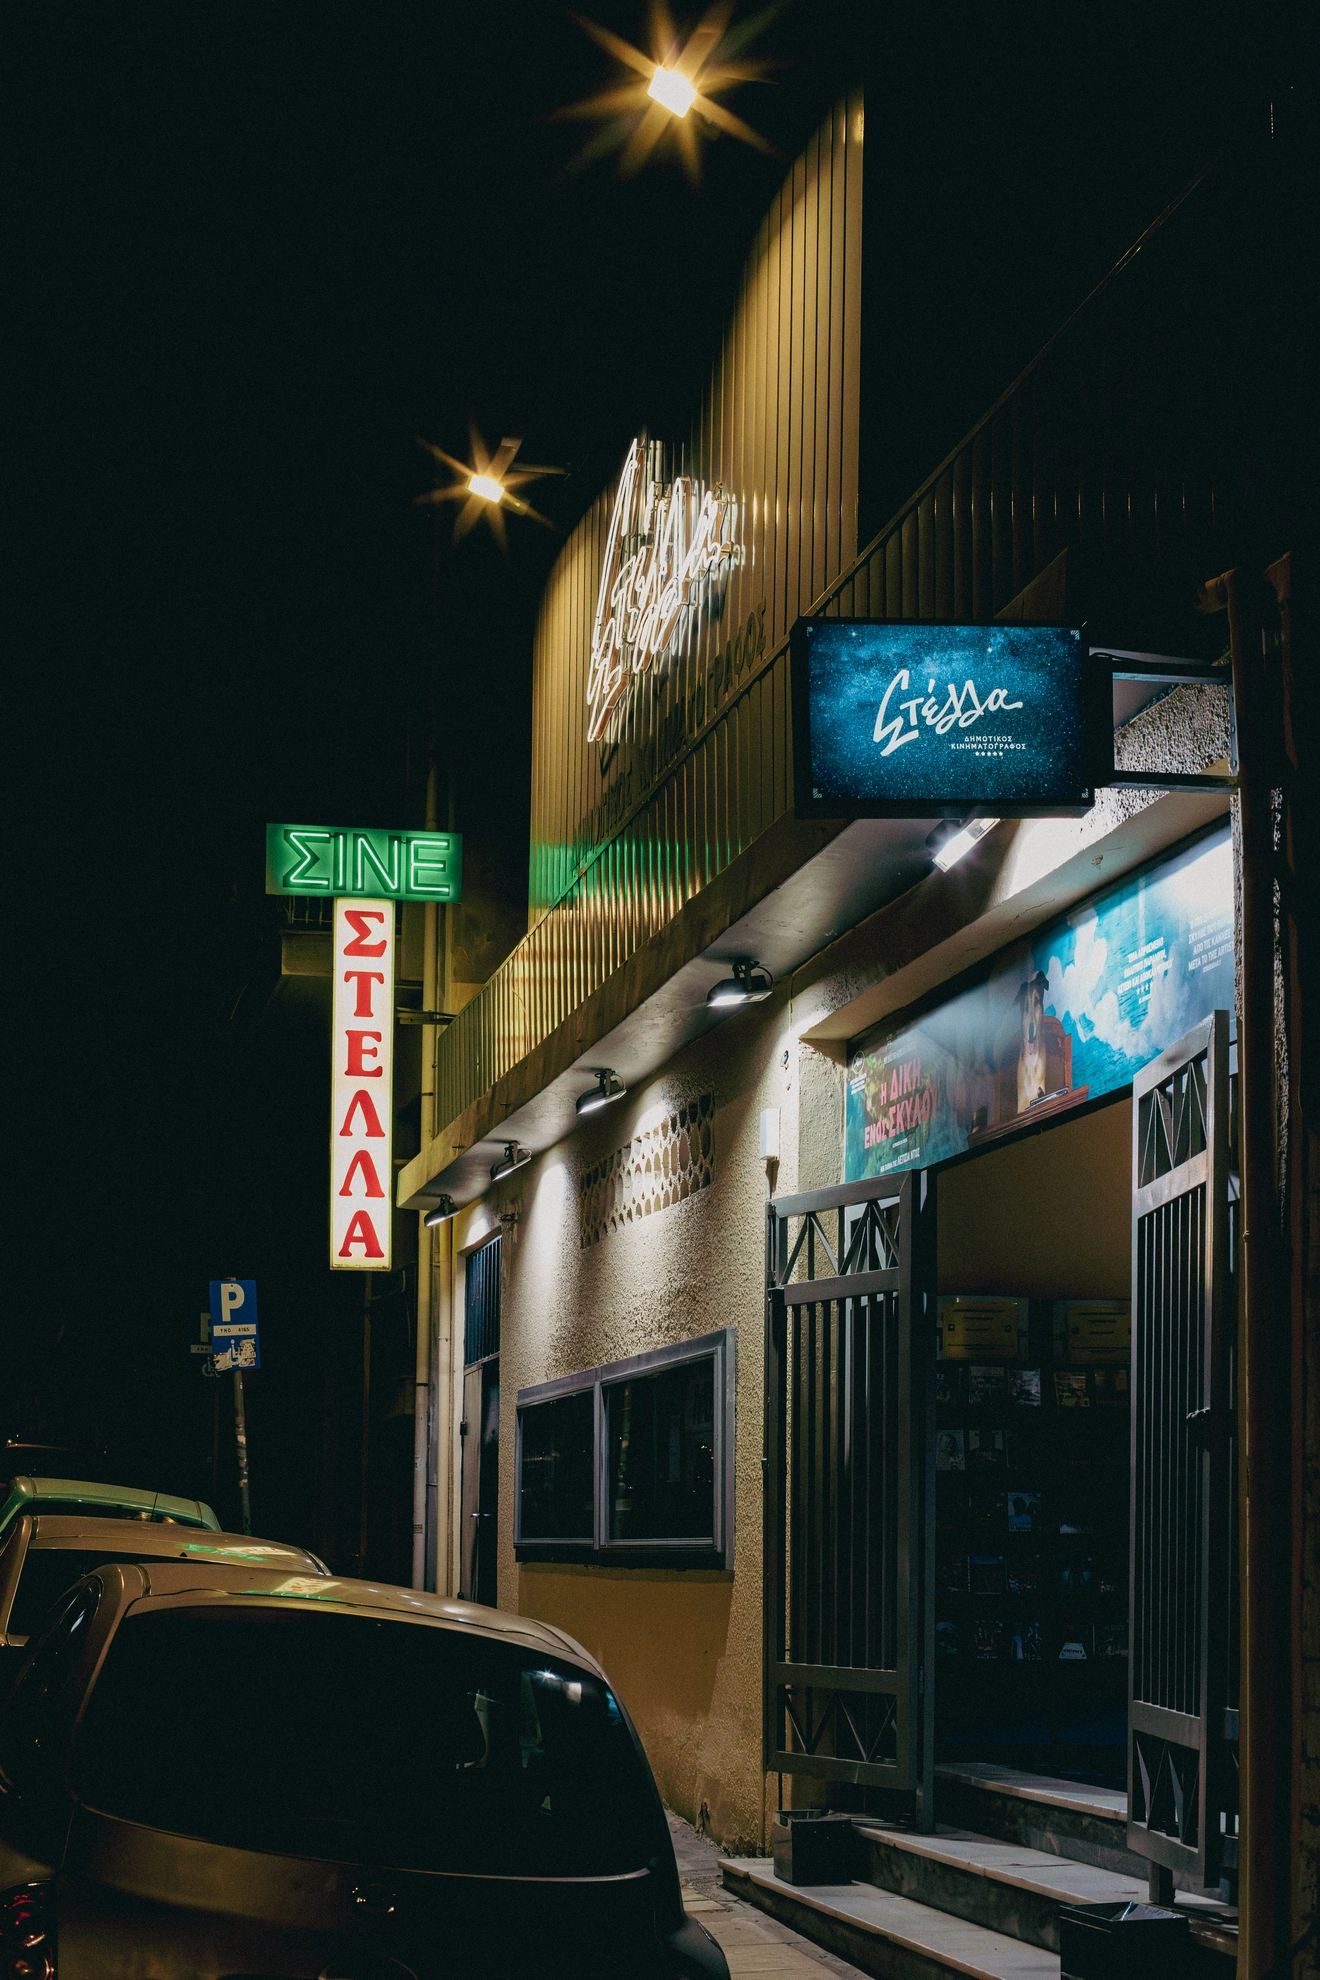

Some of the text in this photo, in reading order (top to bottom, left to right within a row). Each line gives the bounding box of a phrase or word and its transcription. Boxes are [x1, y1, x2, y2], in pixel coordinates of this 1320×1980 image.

[872, 669, 1023, 757] Στέλλα
[338, 910, 388, 1259] ΣΤΕΛΛΑ
[880, 1082, 887, 1106] Η
[889, 1055, 921, 1102] ΔΙΚΗ
[864, 1086, 939, 1150] ΕΝΟΣ ΣΚΥΛΟΥ
[220, 1283, 245, 1322] P
